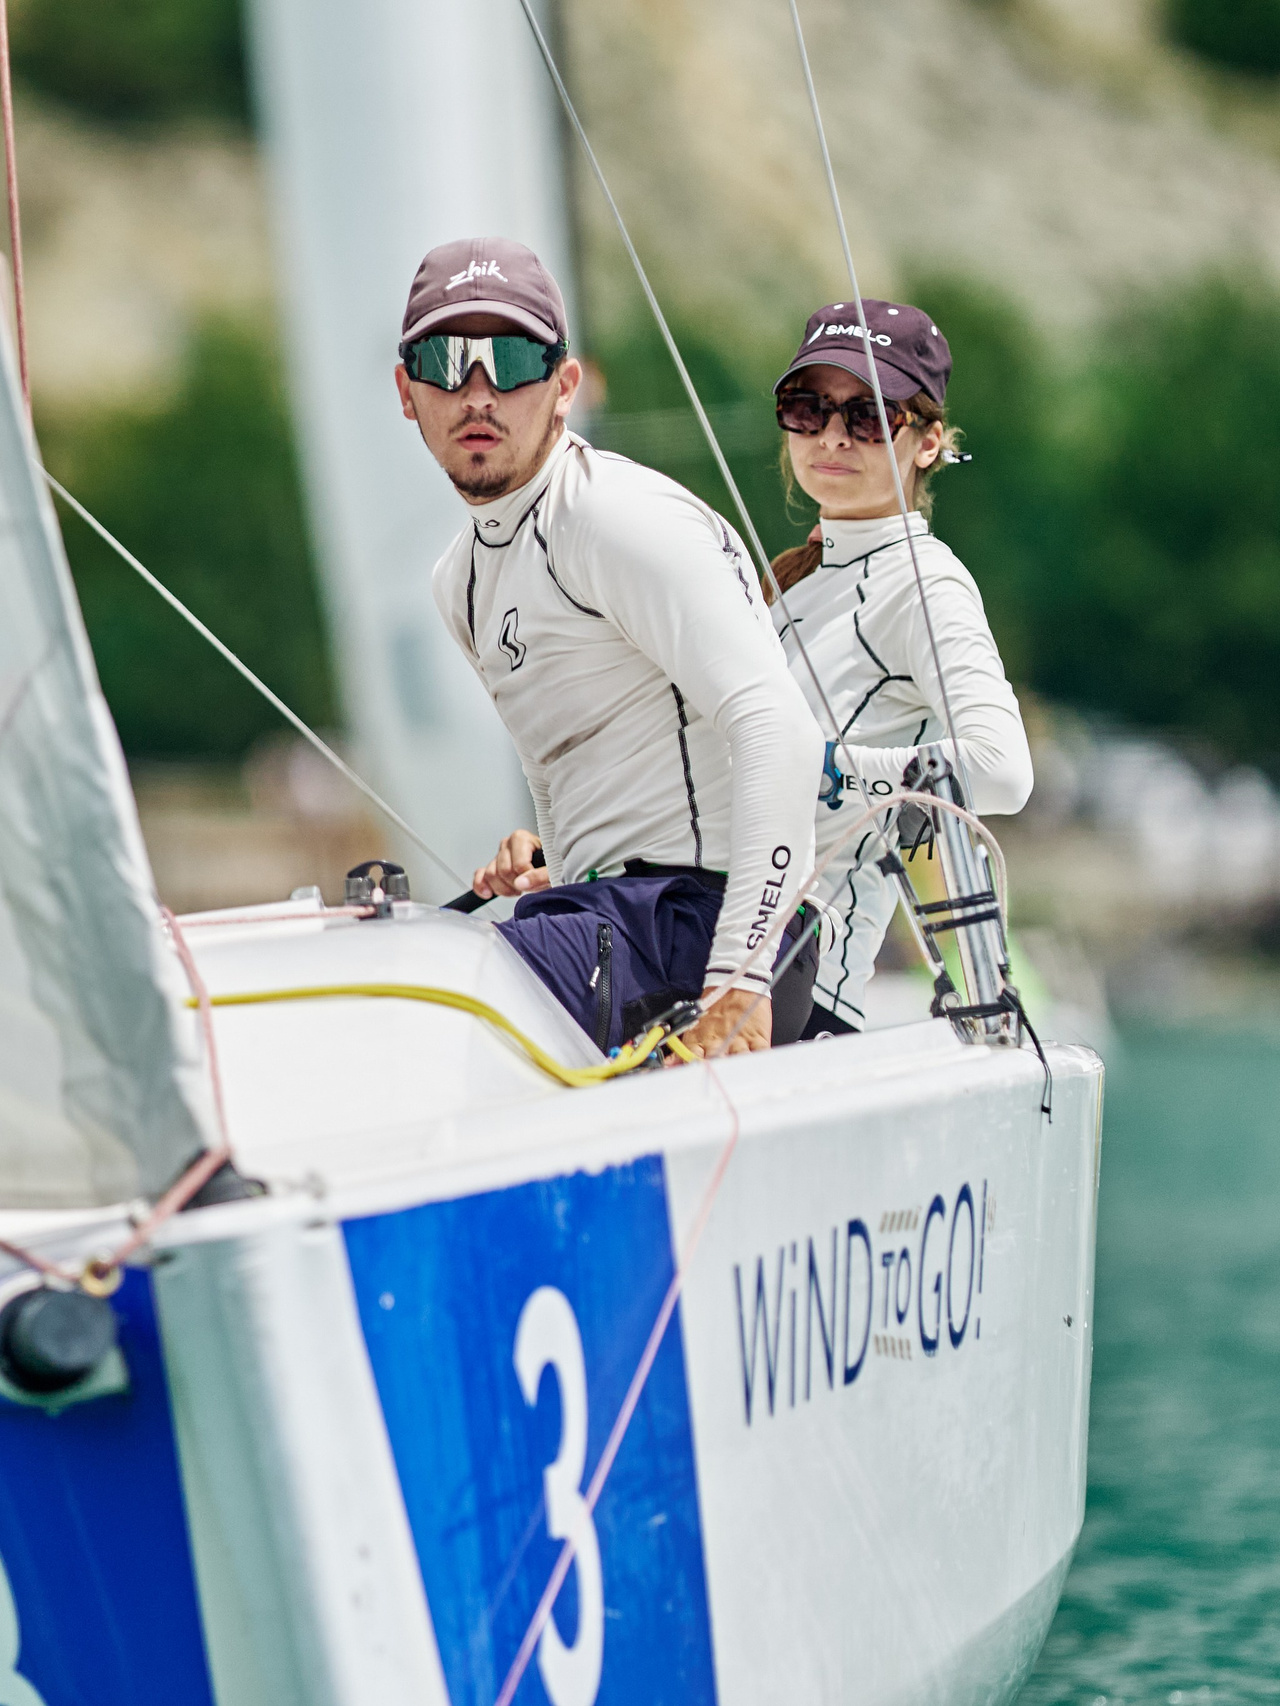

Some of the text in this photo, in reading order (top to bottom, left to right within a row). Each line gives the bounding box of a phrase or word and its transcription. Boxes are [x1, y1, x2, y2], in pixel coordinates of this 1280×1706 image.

[825, 324, 892, 347] SMELO
[746, 845, 792, 951] SMELO
[917, 1178, 988, 1358] GO!
[512, 1284, 605, 1706] 3
